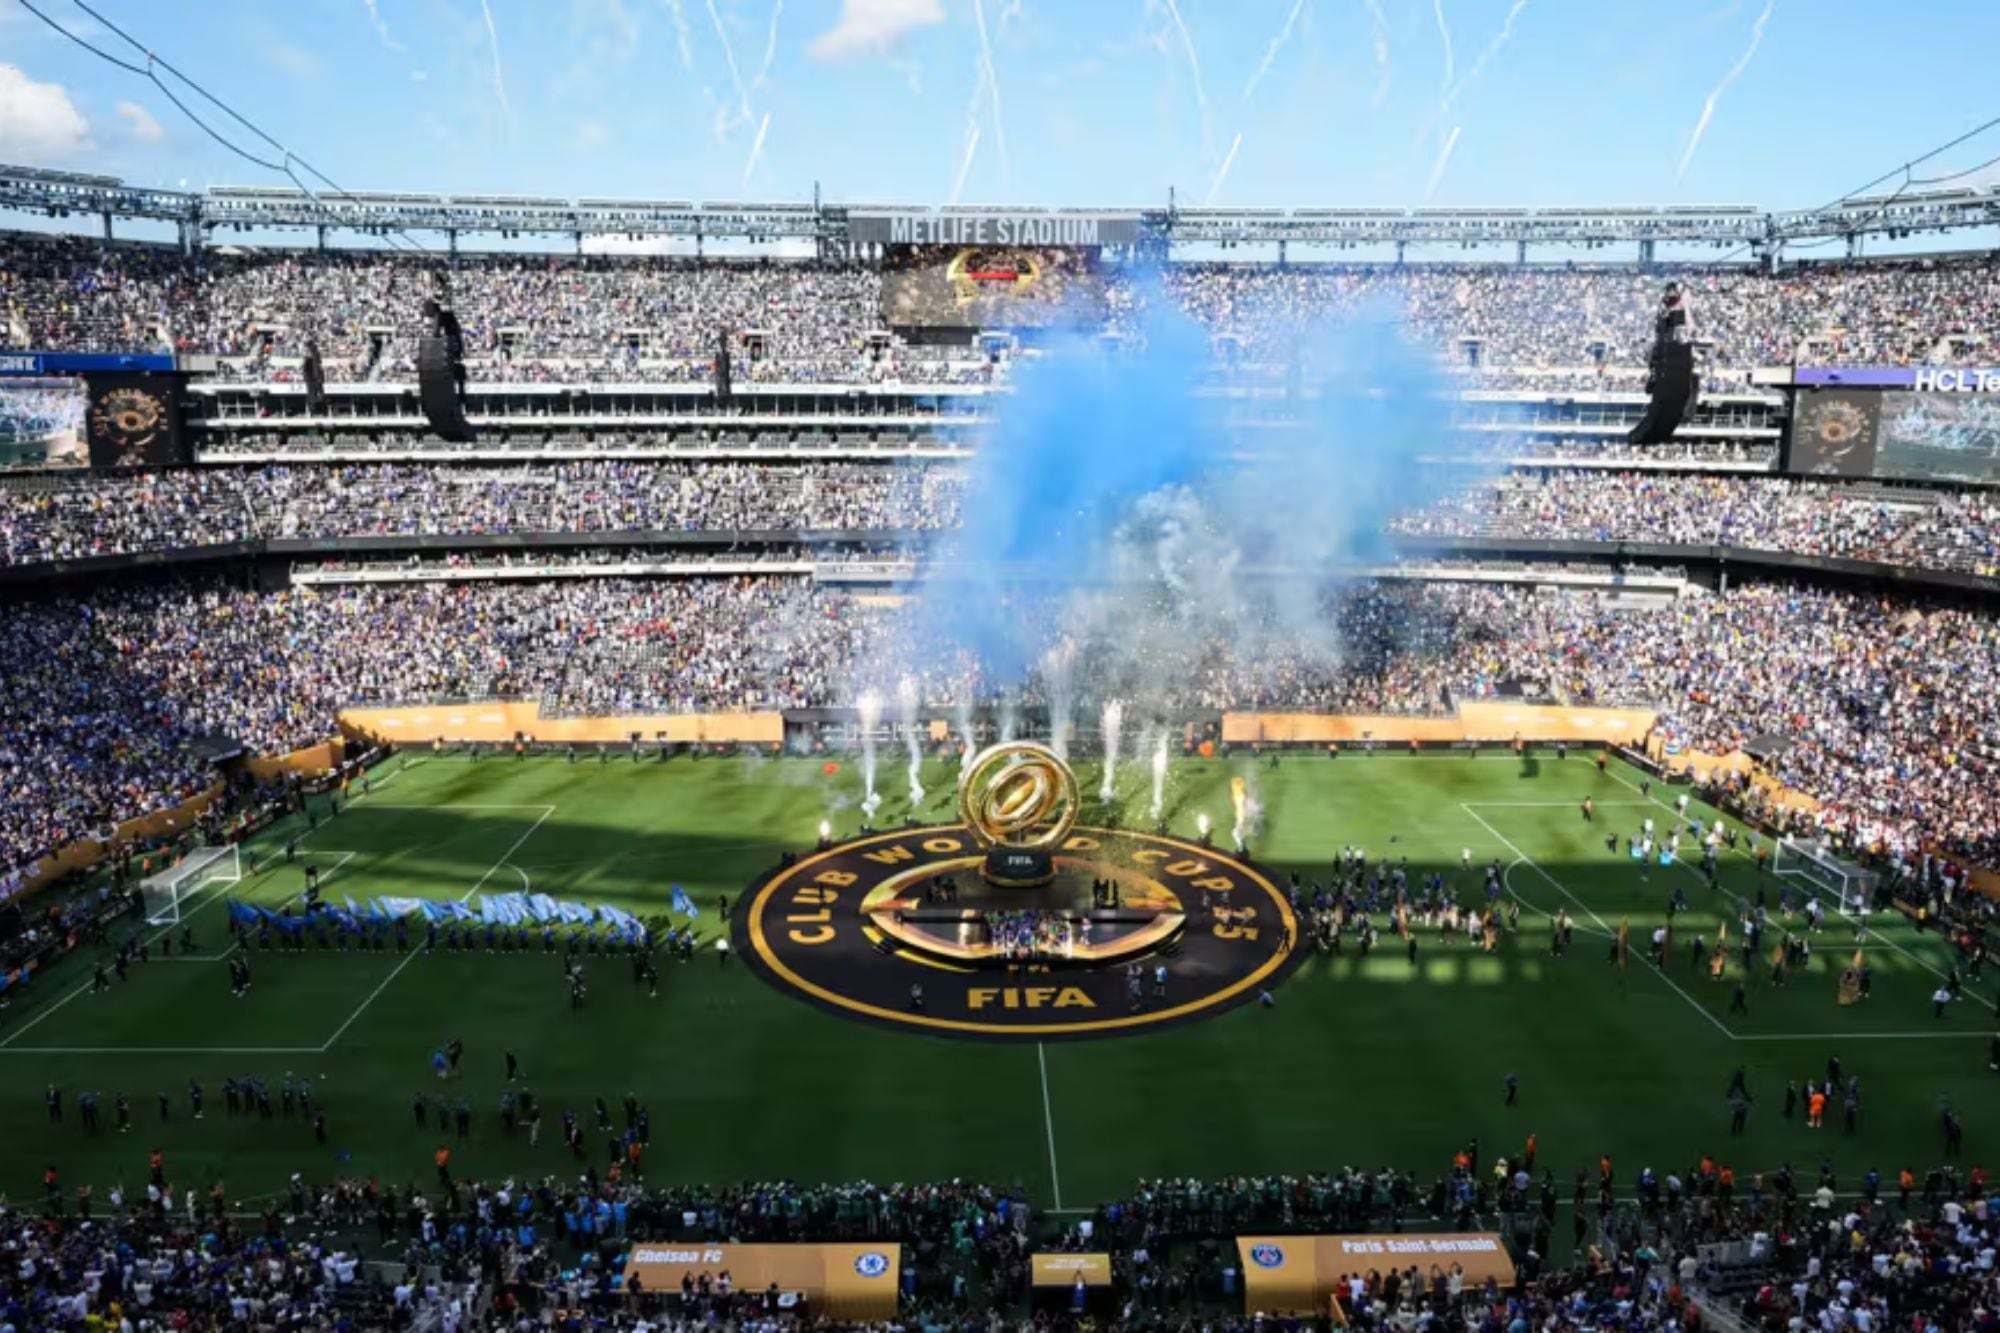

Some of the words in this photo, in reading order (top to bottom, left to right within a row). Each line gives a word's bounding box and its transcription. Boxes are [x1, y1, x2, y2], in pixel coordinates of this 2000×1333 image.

[891, 216, 989, 244] METLIFE
[997, 217, 1099, 245] STADIUM
[1008, 855, 1033, 866] FIFA
[787, 869, 858, 945] CLUB
[862, 838, 1100, 865] WOD
[1131, 850, 1234, 891] CUP
[968, 987, 1097, 1009] FIFA
[1342, 1240, 1384, 1253] Paris
[1386, 1237, 1498, 1252] Saint-Germain
[635, 1249, 699, 1263] Chelsea
[703, 1248, 723, 1263] FC
